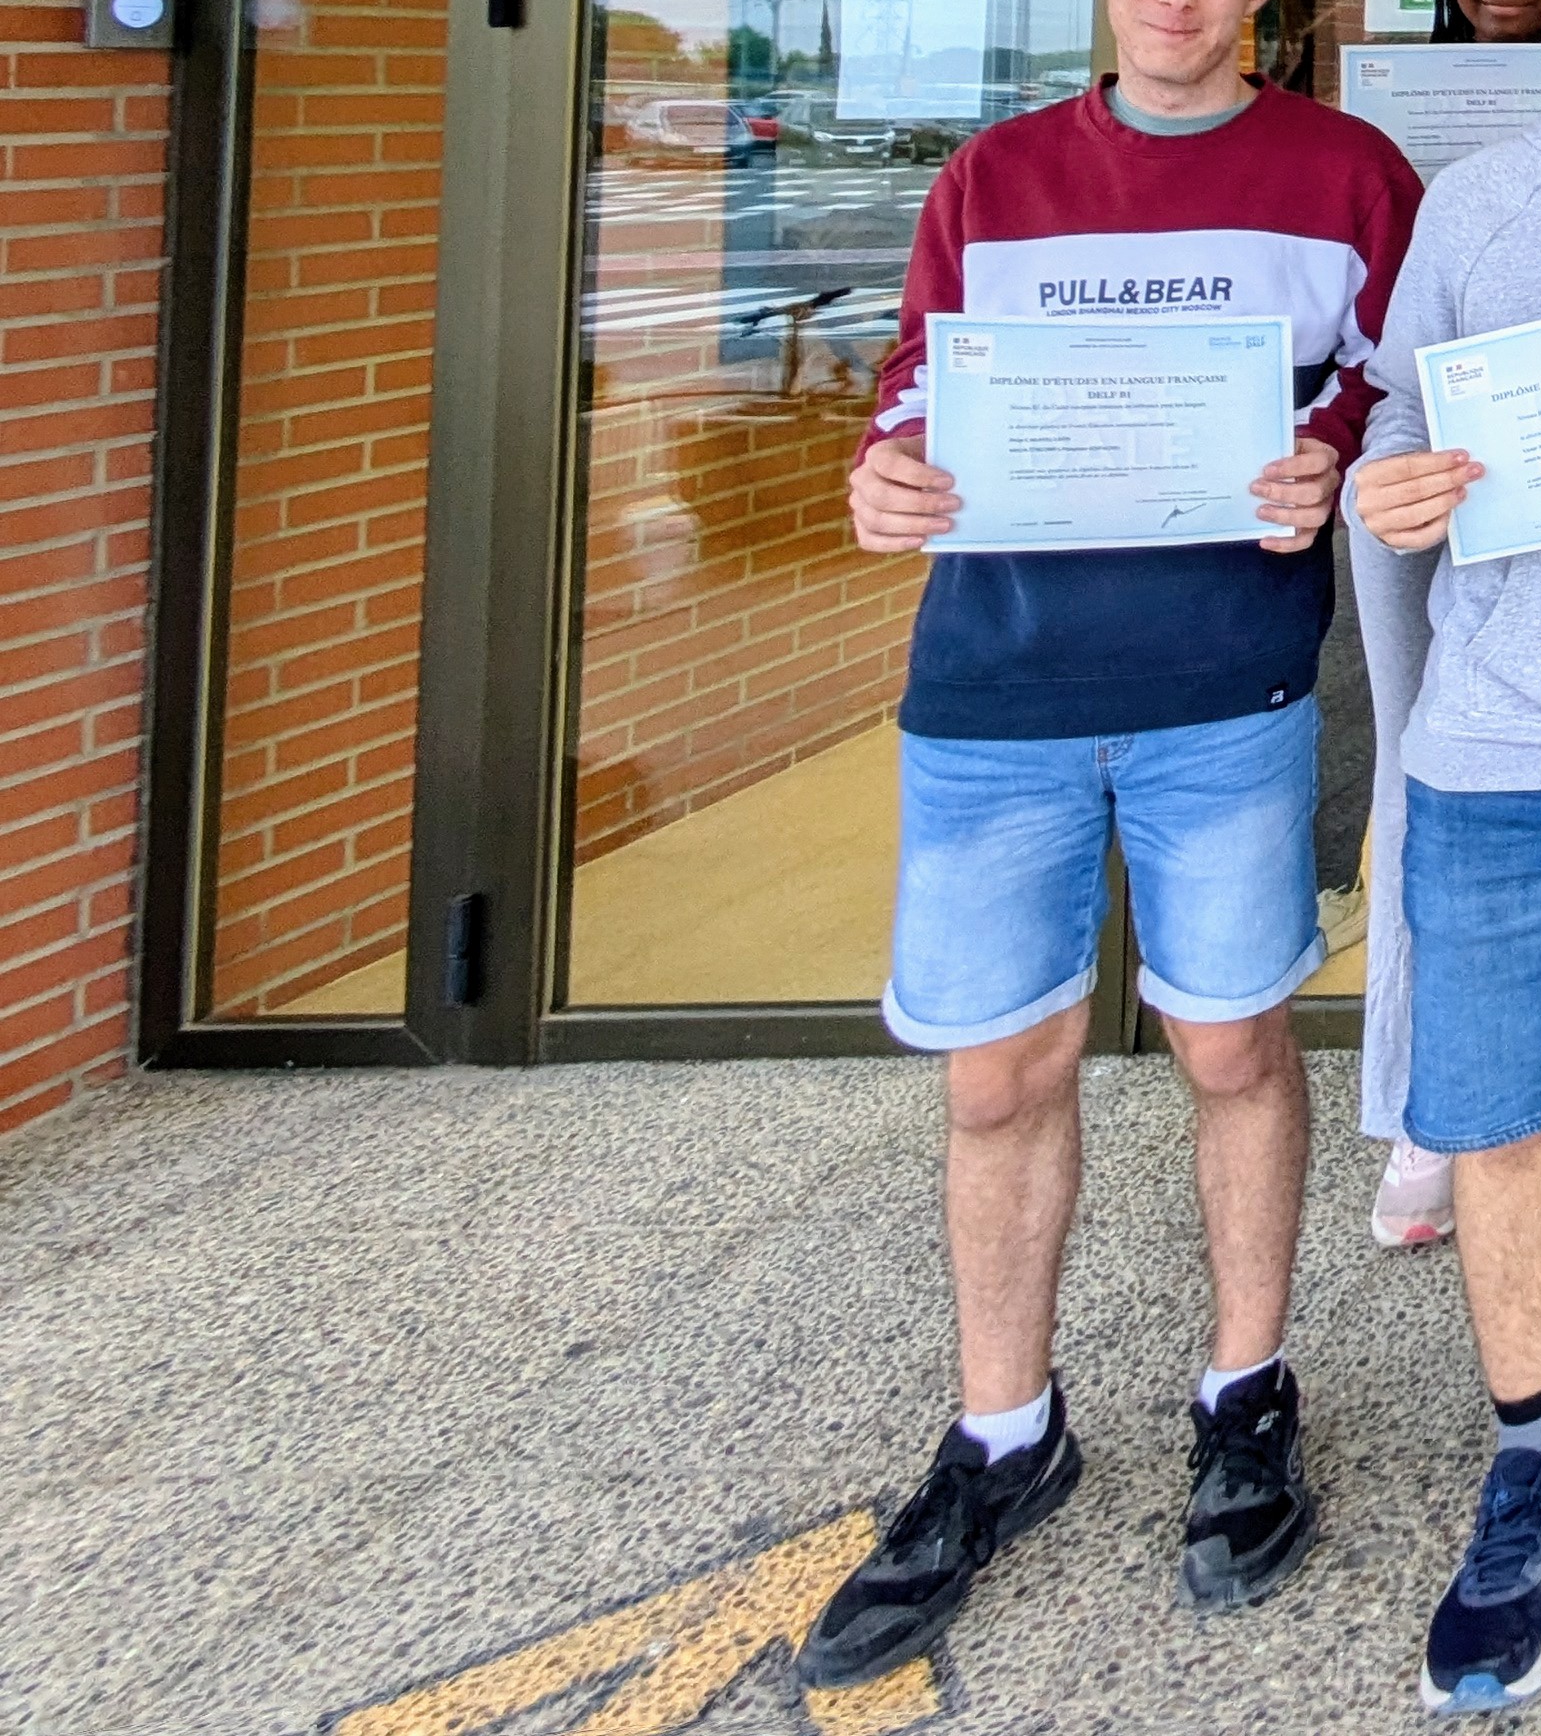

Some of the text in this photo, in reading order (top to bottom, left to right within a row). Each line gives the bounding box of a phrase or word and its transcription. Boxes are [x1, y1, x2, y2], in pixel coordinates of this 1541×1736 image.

[1039, 276, 1233, 308] PULL&BEAR
[1126, 306, 1160, 315] MEXICO
[1161, 304, 1179, 314] CITY
[1101, 376, 1117, 385] EN
[1120, 376, 1166, 384] LANGUE
[1491, 384, 1541, 402] DIPLÔME
